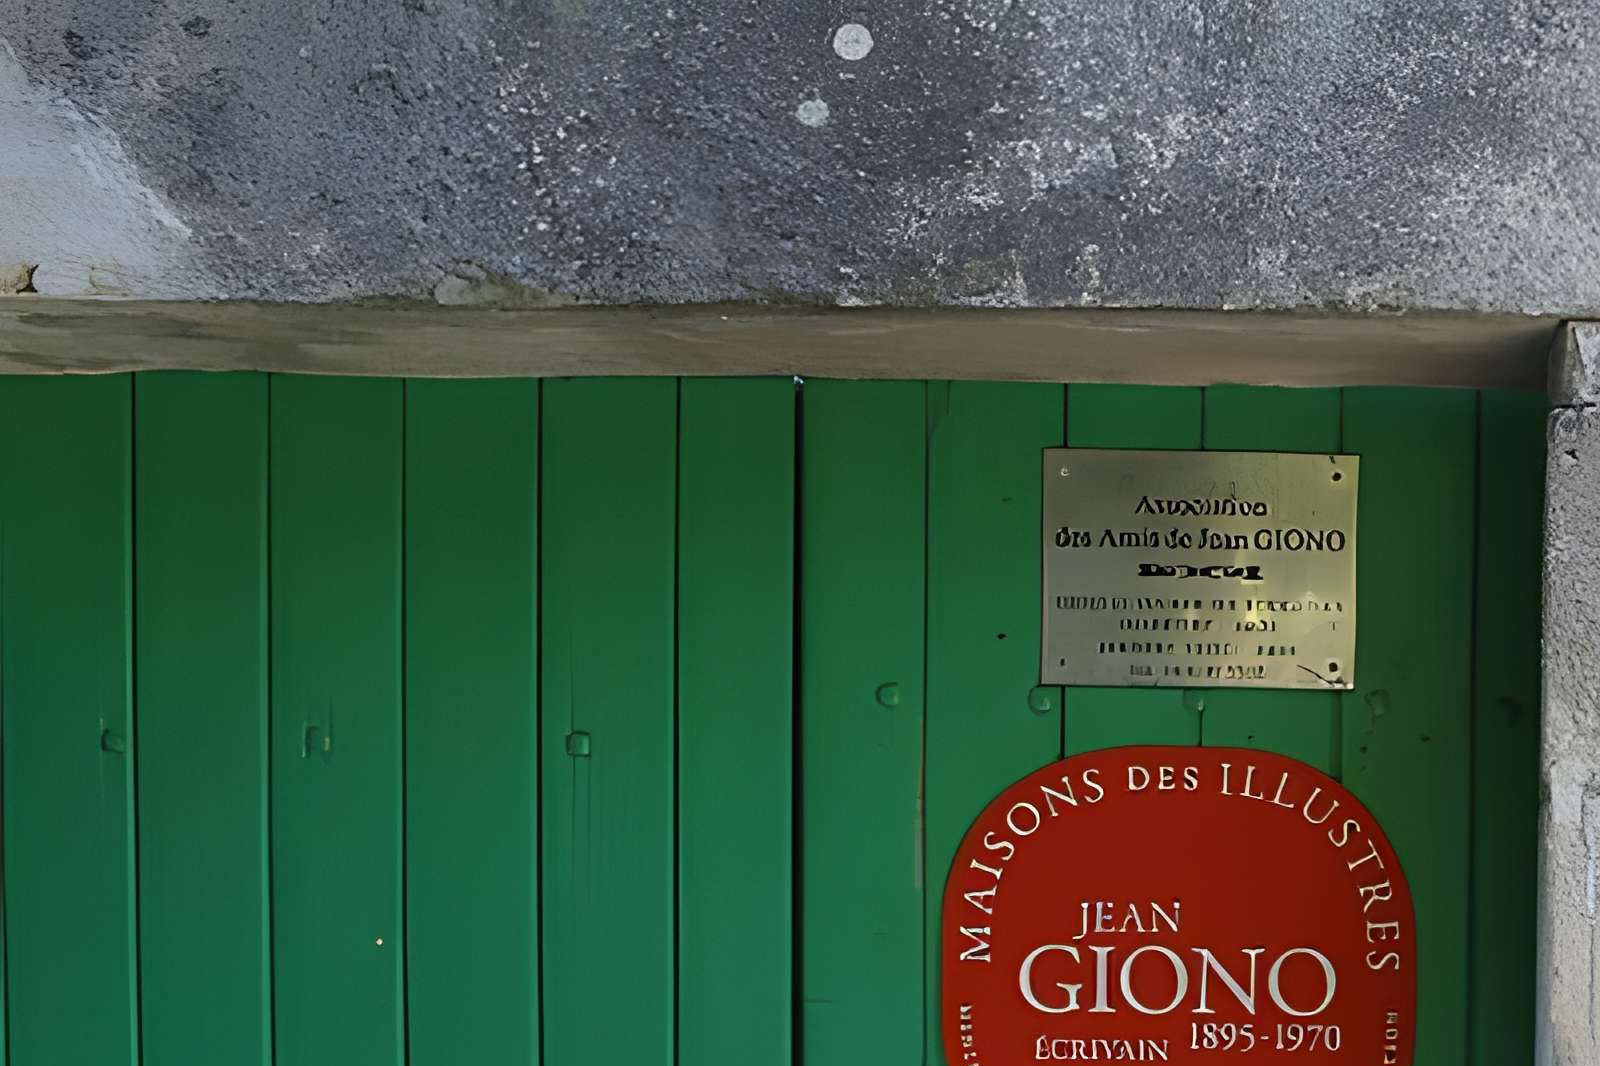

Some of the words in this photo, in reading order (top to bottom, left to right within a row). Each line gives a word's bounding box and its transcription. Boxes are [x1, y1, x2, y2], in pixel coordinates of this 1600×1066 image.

[1253, 528, 1346, 552] GIONO
[959, 768, 1105, 963] MAISONS
[1127, 765, 1199, 791] DES
[1219, 763, 1400, 971] ILLUSTRES
[1072, 901, 1181, 940] JEAN
[1018, 944, 1337, 1017] GIONO
[1035, 1034, 1169, 1061] ÉCRIVAIN
[1190, 1022, 1341, 1052] 1895-1970
